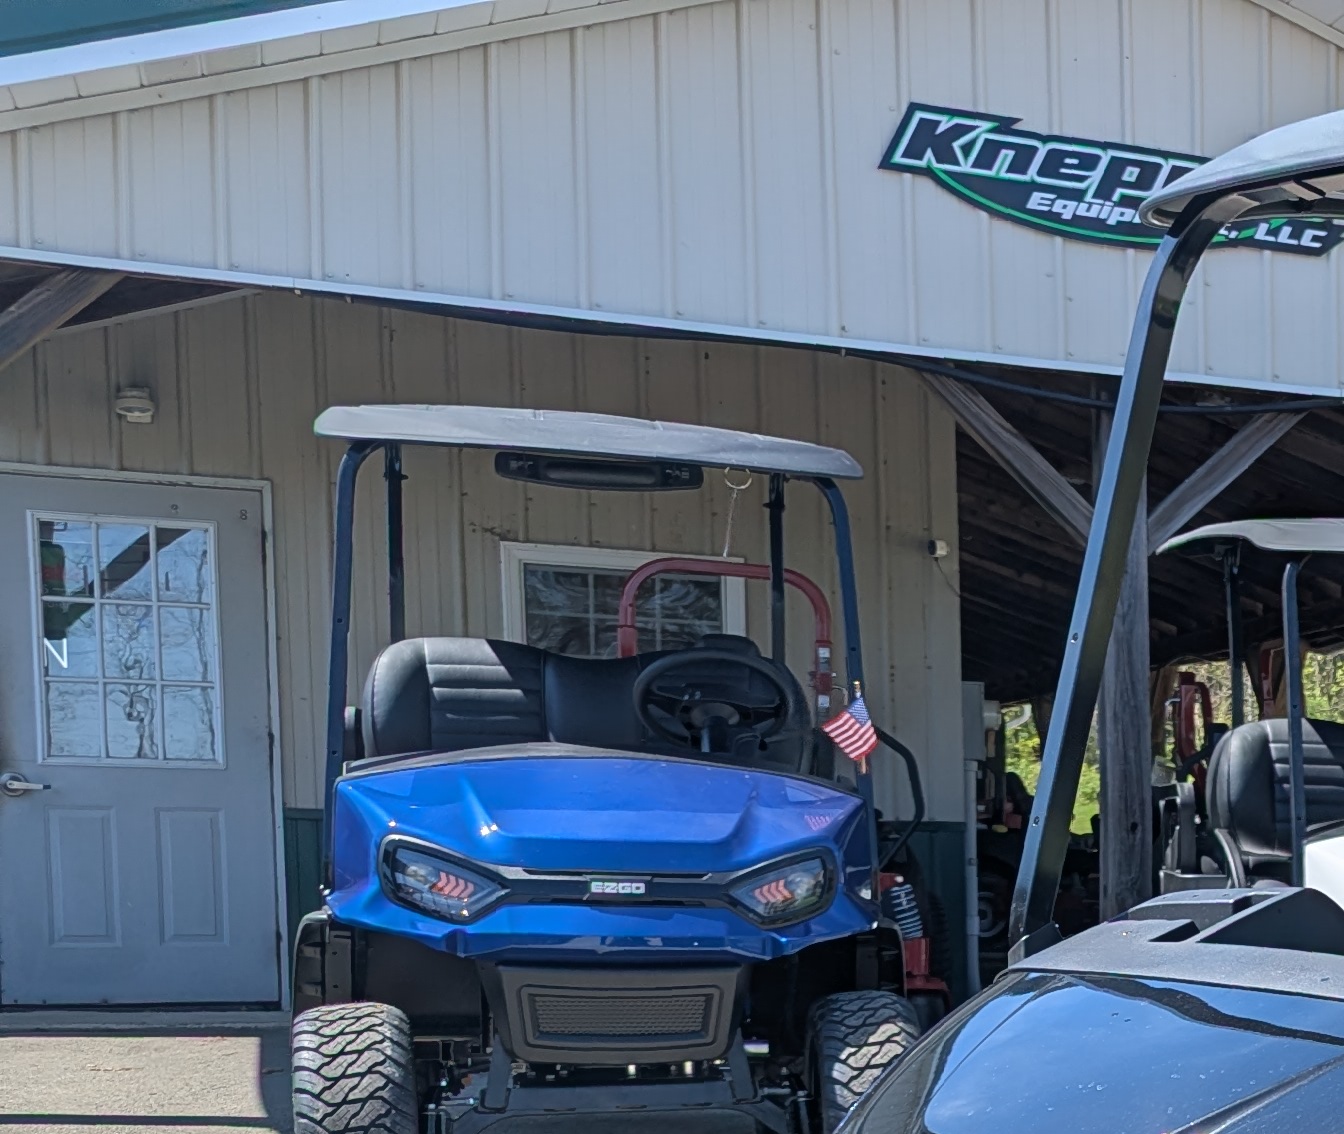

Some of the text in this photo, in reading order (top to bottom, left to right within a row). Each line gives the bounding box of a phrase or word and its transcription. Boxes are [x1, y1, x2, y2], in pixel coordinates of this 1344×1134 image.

[892, 111, 1200, 202] Knep
[1254, 222, 1329, 248] LLC
[591, 881, 645, 894] EZGO
